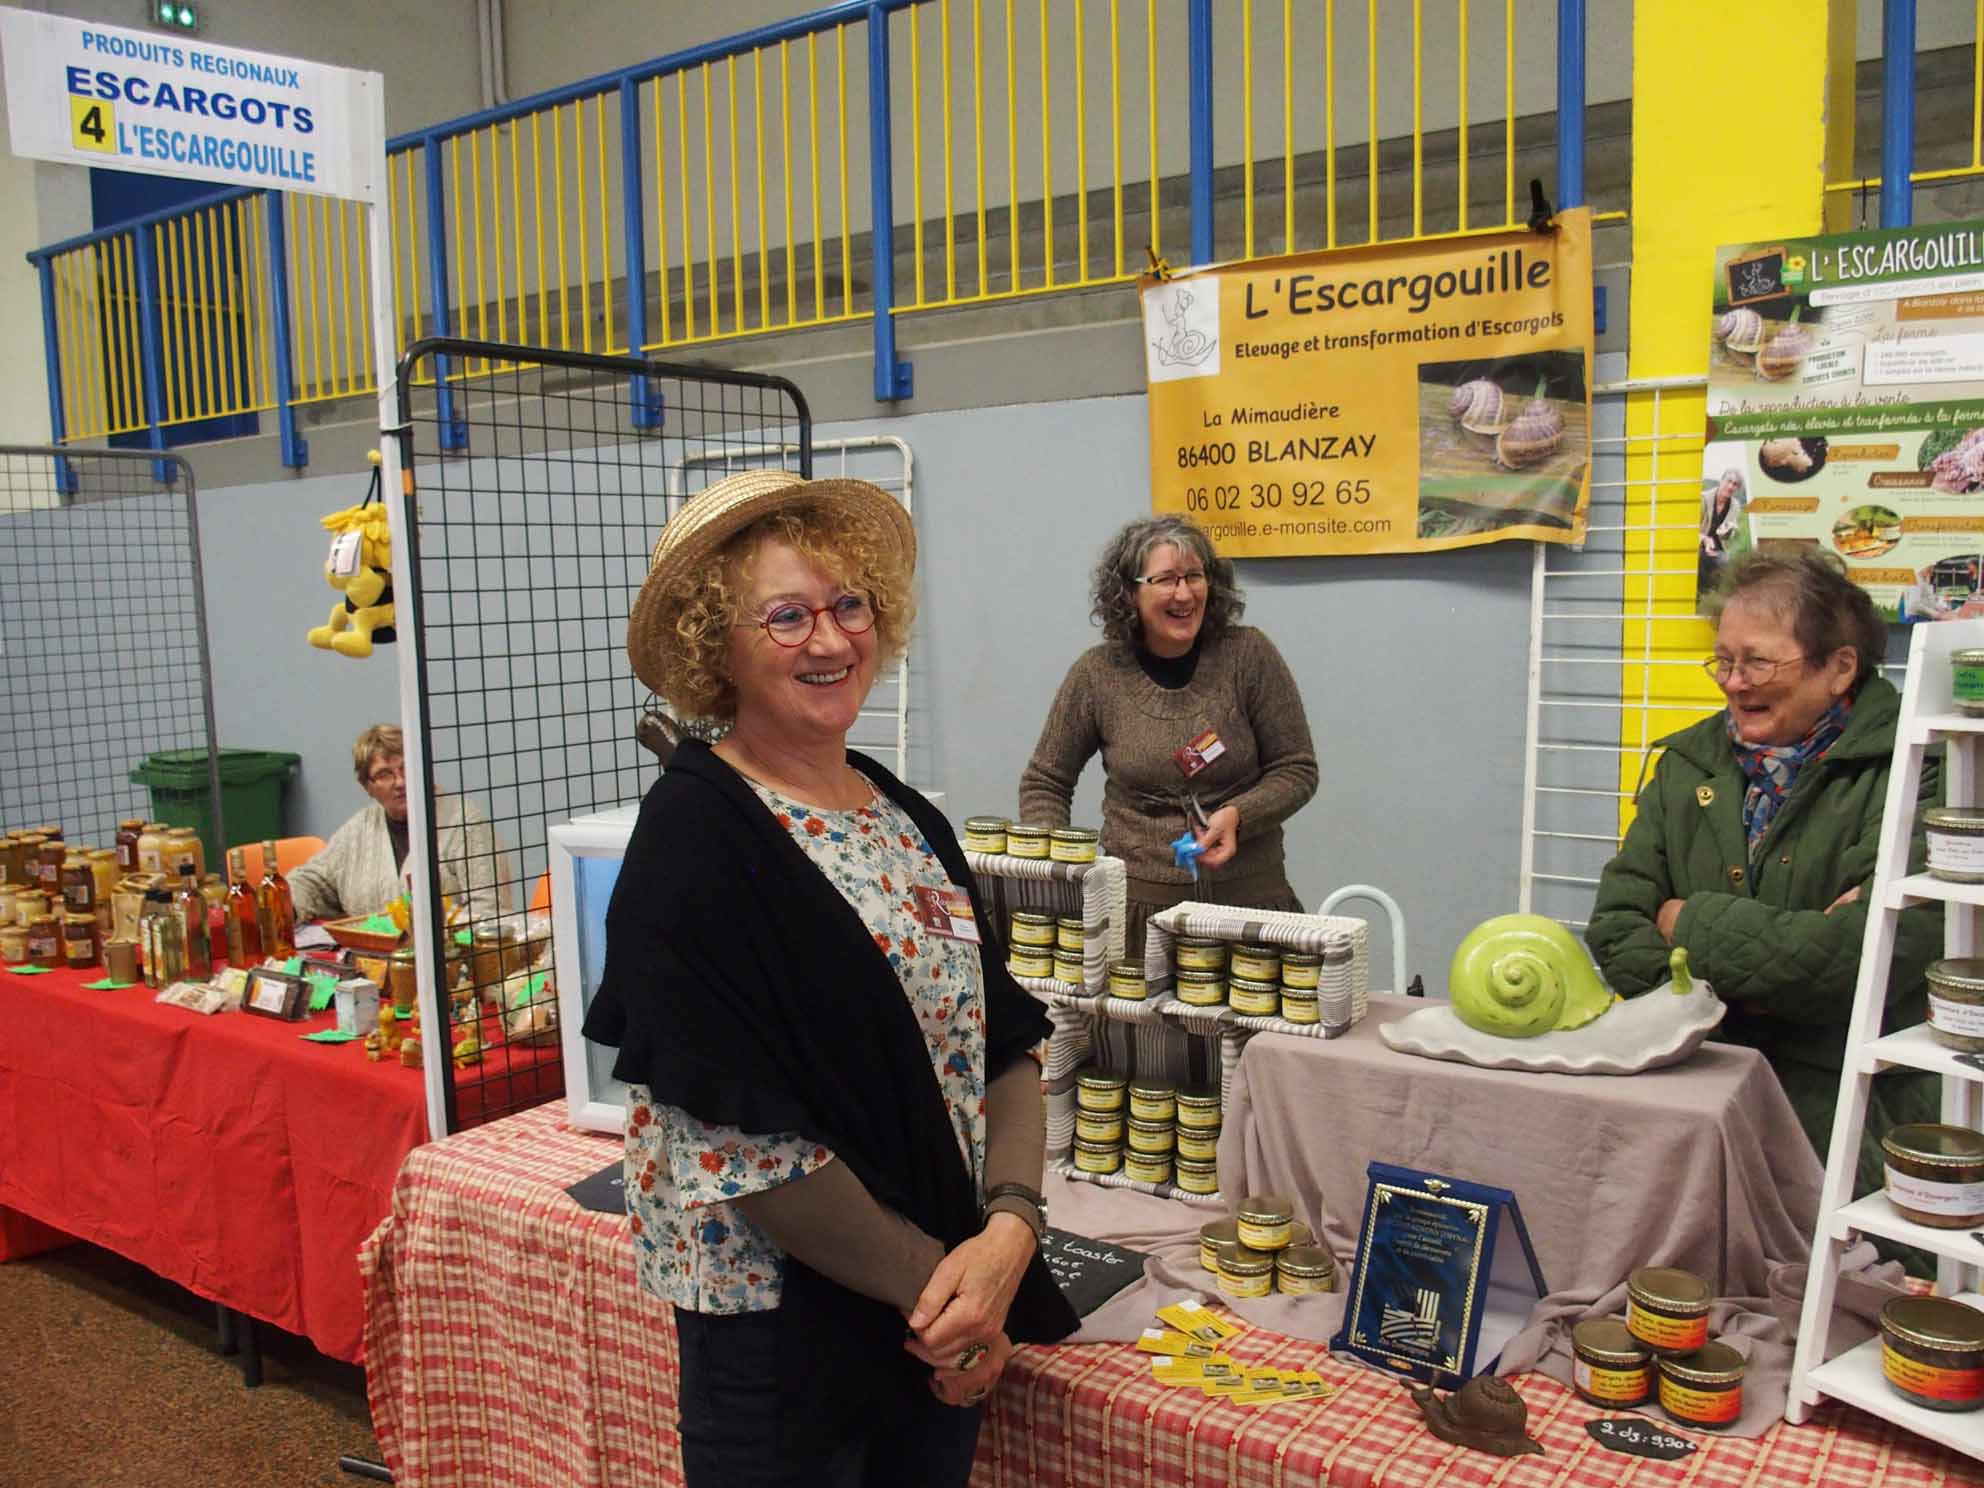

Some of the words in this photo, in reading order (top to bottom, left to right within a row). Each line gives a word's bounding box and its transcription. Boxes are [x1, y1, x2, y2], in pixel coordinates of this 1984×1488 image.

[82, 30, 184, 67] PRODUITS
[190, 52, 300, 89] REGIONAUX
[66, 65, 314, 134] ESCARGOTS
[80, 106, 105, 143] 4
[119, 121, 315, 182] L'ESCARGOUILLE
[1811, 232, 1984, 282] L'ESCARGOUIL
[1235, 342, 1299, 359] Elevage
[1304, 335, 1320, 351] et
[1324, 323, 1460, 350] transformation
[1465, 311, 1564, 336] d'Escargots
[1203, 410, 1222, 428] La
[1231, 402, 1340, 425] Mimaudière
[1178, 443, 1236, 468] 86400
[1248, 434, 1376, 463] BLANZAY
[1186, 487, 1208, 512] 06
[1215, 486, 1240, 510] 02
[1250, 483, 1282, 509] 30
[1292, 481, 1325, 506] 92
[1336, 480, 1371, 504] 65
[1199, 517, 1391, 541] argouille.e-monsite.com
[1600, 1422, 1614, 1435] 2
